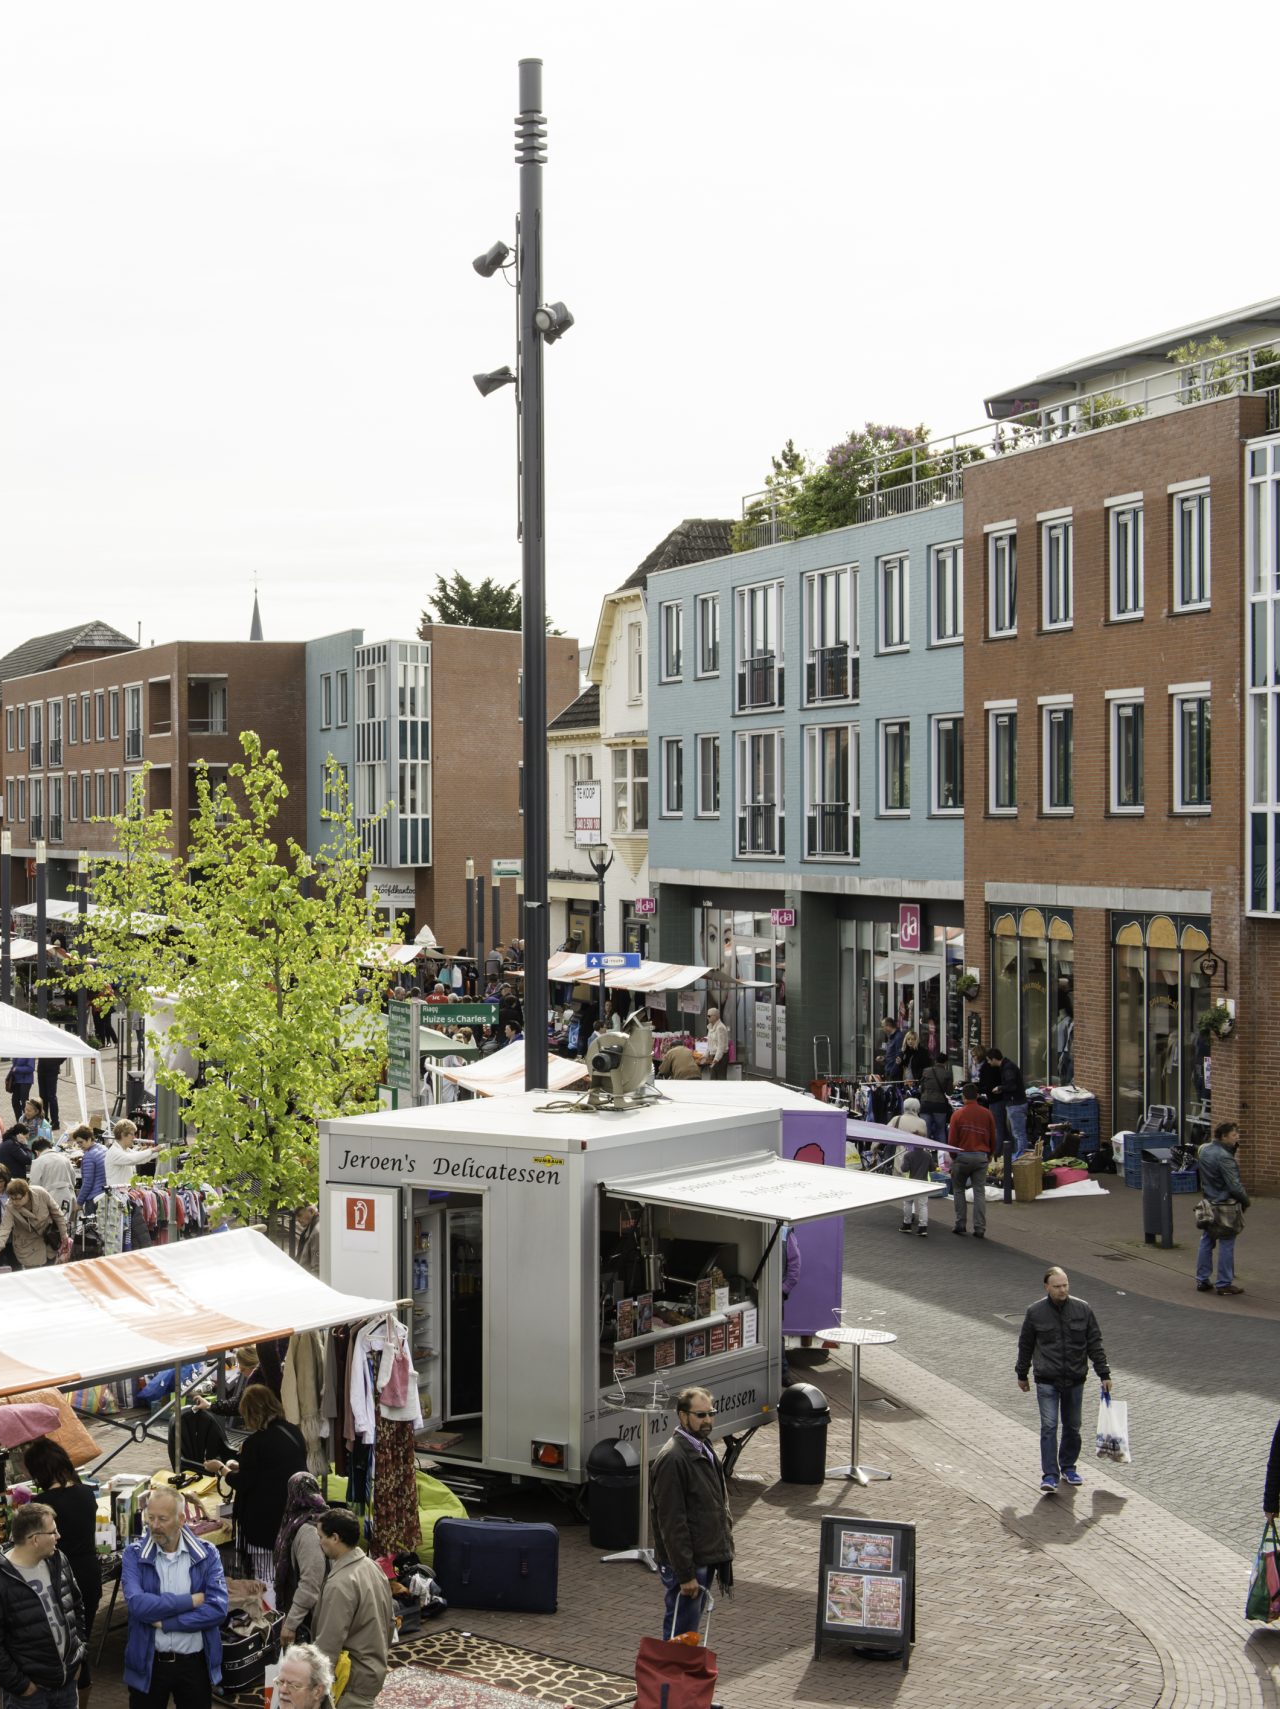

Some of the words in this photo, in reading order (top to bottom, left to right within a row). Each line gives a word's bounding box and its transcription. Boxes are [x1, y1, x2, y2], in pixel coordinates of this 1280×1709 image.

[374, 885, 416, 896] Hoofdkantoo
[422, 1015, 446, 1023] Huize
[456, 1015, 487, 1023] Charles
[533, 1157, 564, 1165] HUMBAUR
[338, 1150, 416, 1173] Jeroen's
[433, 1157, 561, 1185] Delicatessen
[618, 1413, 669, 1441] Jern's
[712, 1387, 757, 1415] atessen
